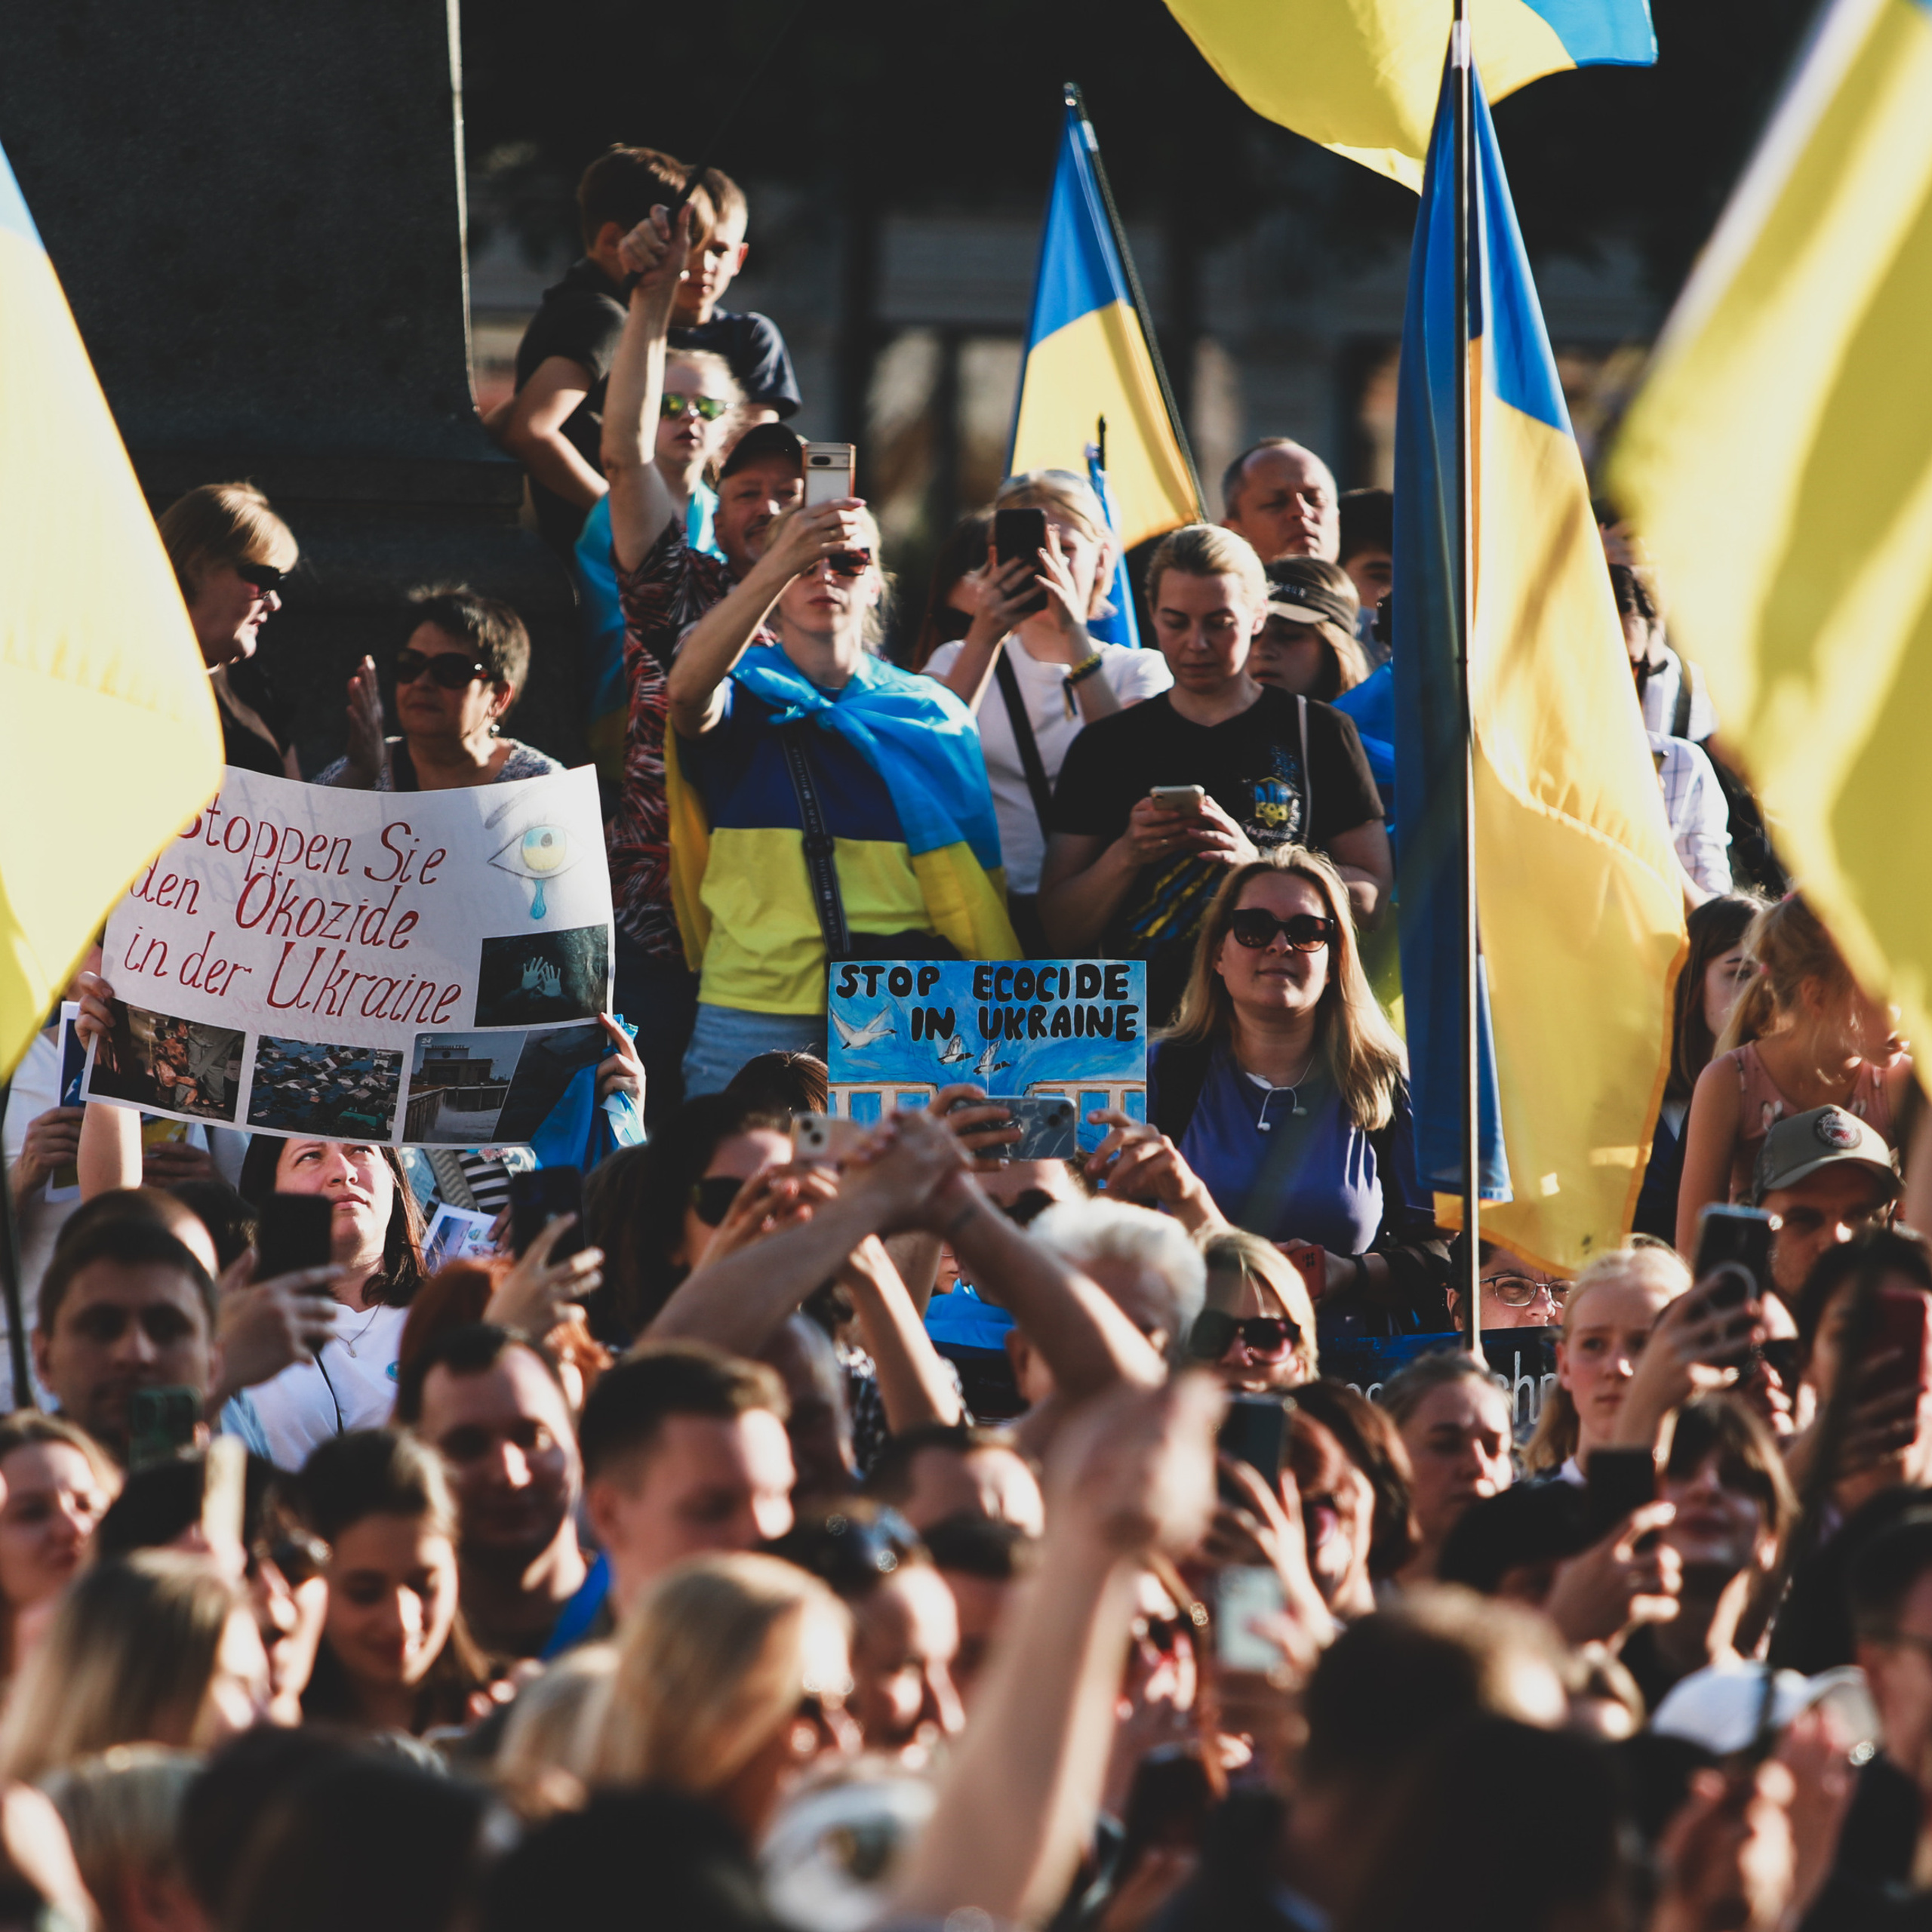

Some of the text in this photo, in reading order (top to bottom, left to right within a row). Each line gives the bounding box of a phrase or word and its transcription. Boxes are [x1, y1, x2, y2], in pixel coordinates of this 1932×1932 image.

[363, 820, 448, 886] Sie
[130, 850, 420, 950] den Ökozide
[124, 925, 463, 1025] in der Ukraine
[835, 963, 1131, 1003] STOP ECOCIDE
[910, 1004, 1140, 1042] IN UKRAINE
